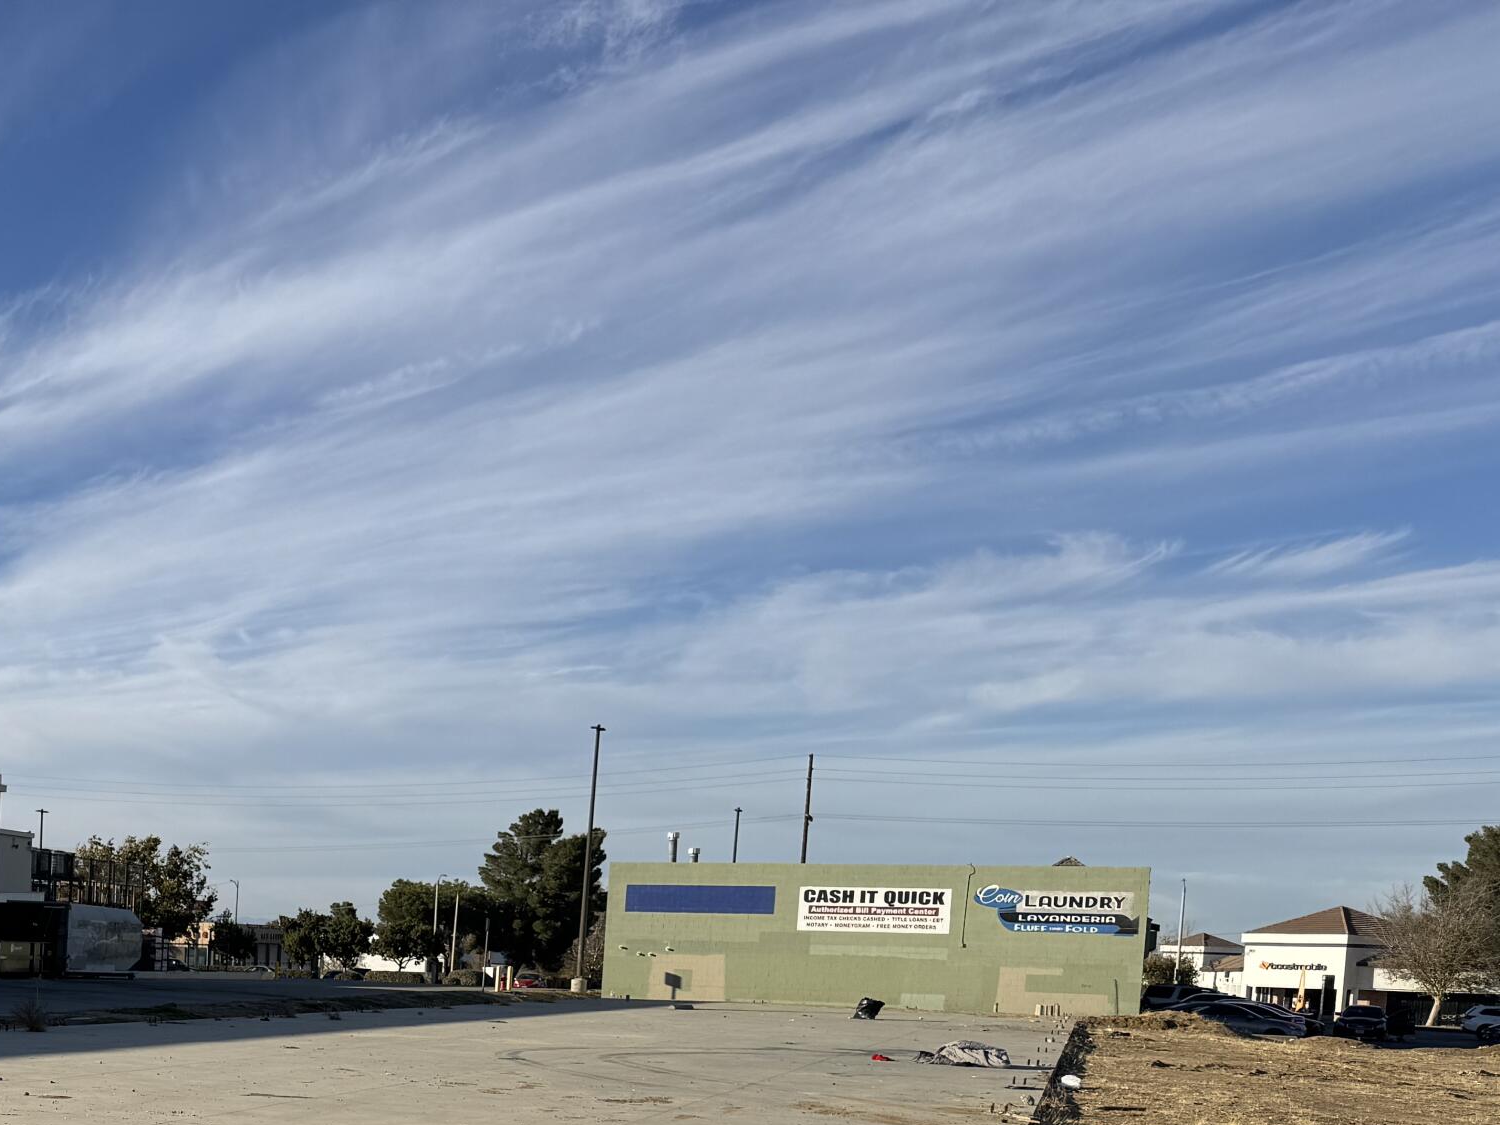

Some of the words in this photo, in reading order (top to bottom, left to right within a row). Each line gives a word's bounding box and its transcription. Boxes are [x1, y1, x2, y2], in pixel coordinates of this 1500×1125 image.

[804, 889, 854, 903] CASH
[860, 891, 878, 903] IT
[884, 891, 945, 906] QUICK
[976, 884, 1021, 904] Coin
[1024, 894, 1126, 908] LAUNDRY
[1018, 914, 1116, 923] LAVANDERIA
[1014, 924, 1048, 932] FLUFF
